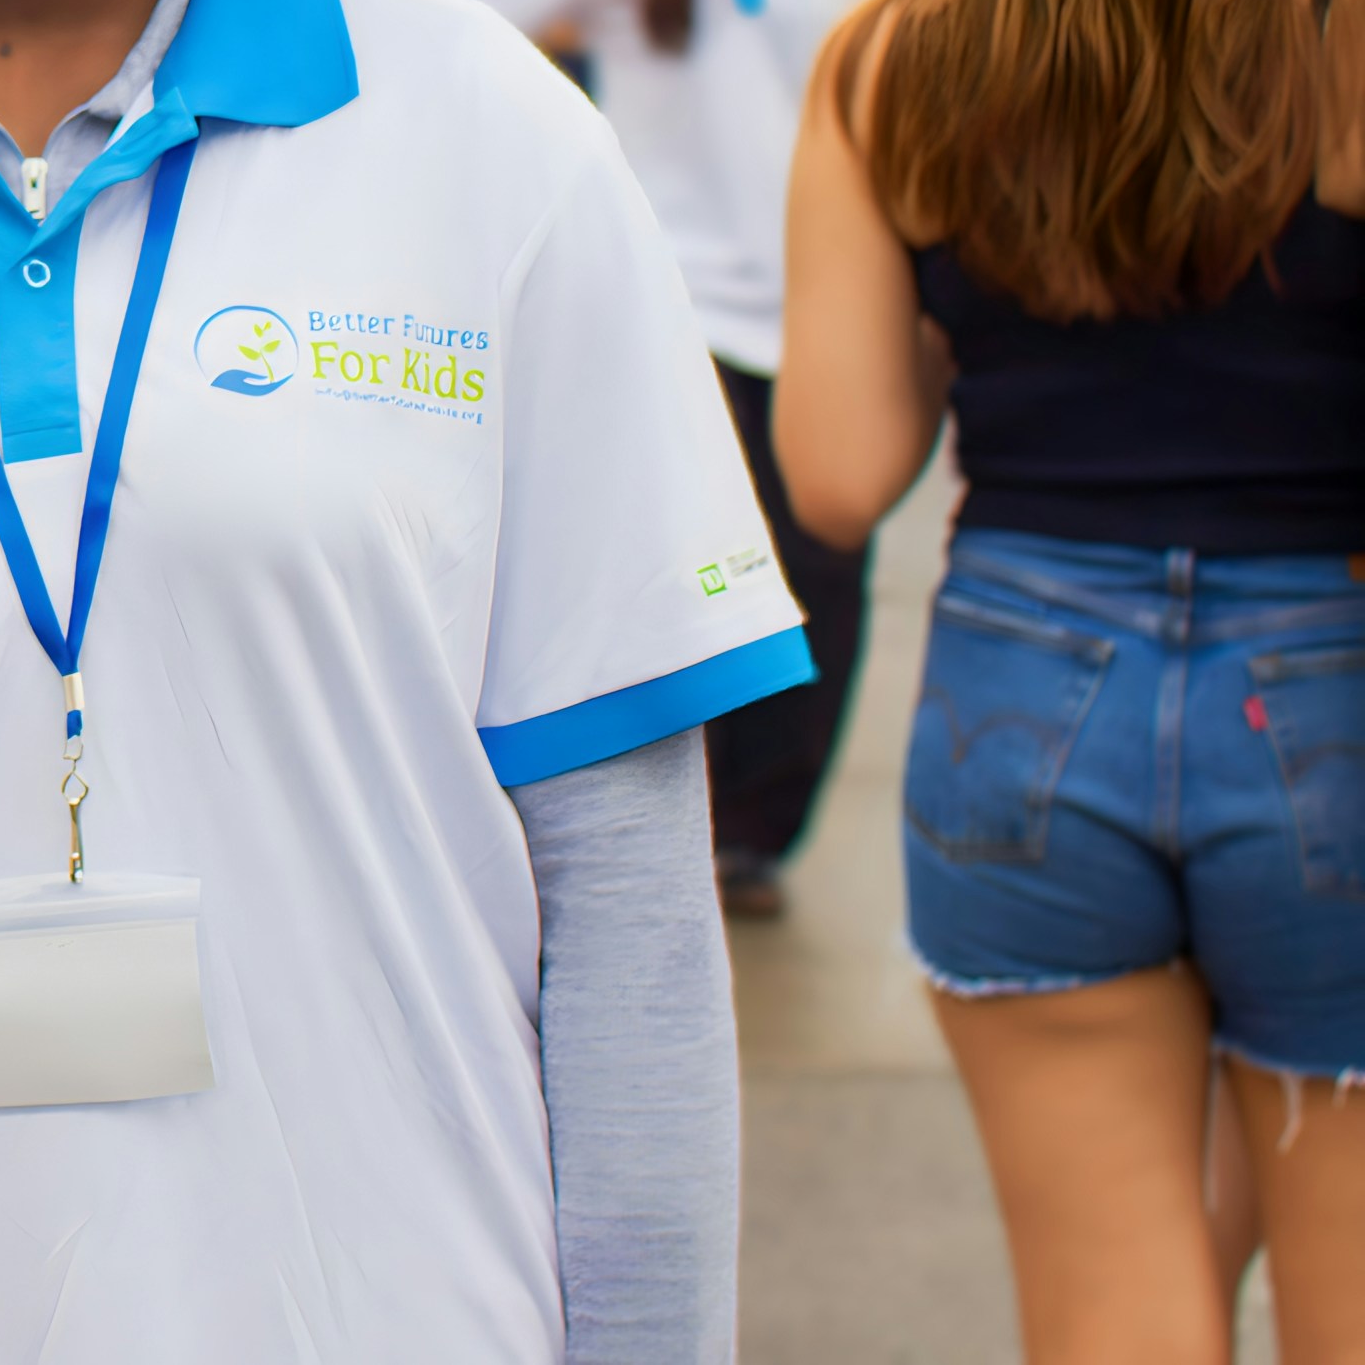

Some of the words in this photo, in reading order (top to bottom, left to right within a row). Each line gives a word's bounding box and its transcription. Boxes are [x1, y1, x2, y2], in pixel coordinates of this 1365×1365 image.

[308, 310, 395, 334] Better
[310, 341, 390, 384] For
[401, 347, 486, 403] Kids
